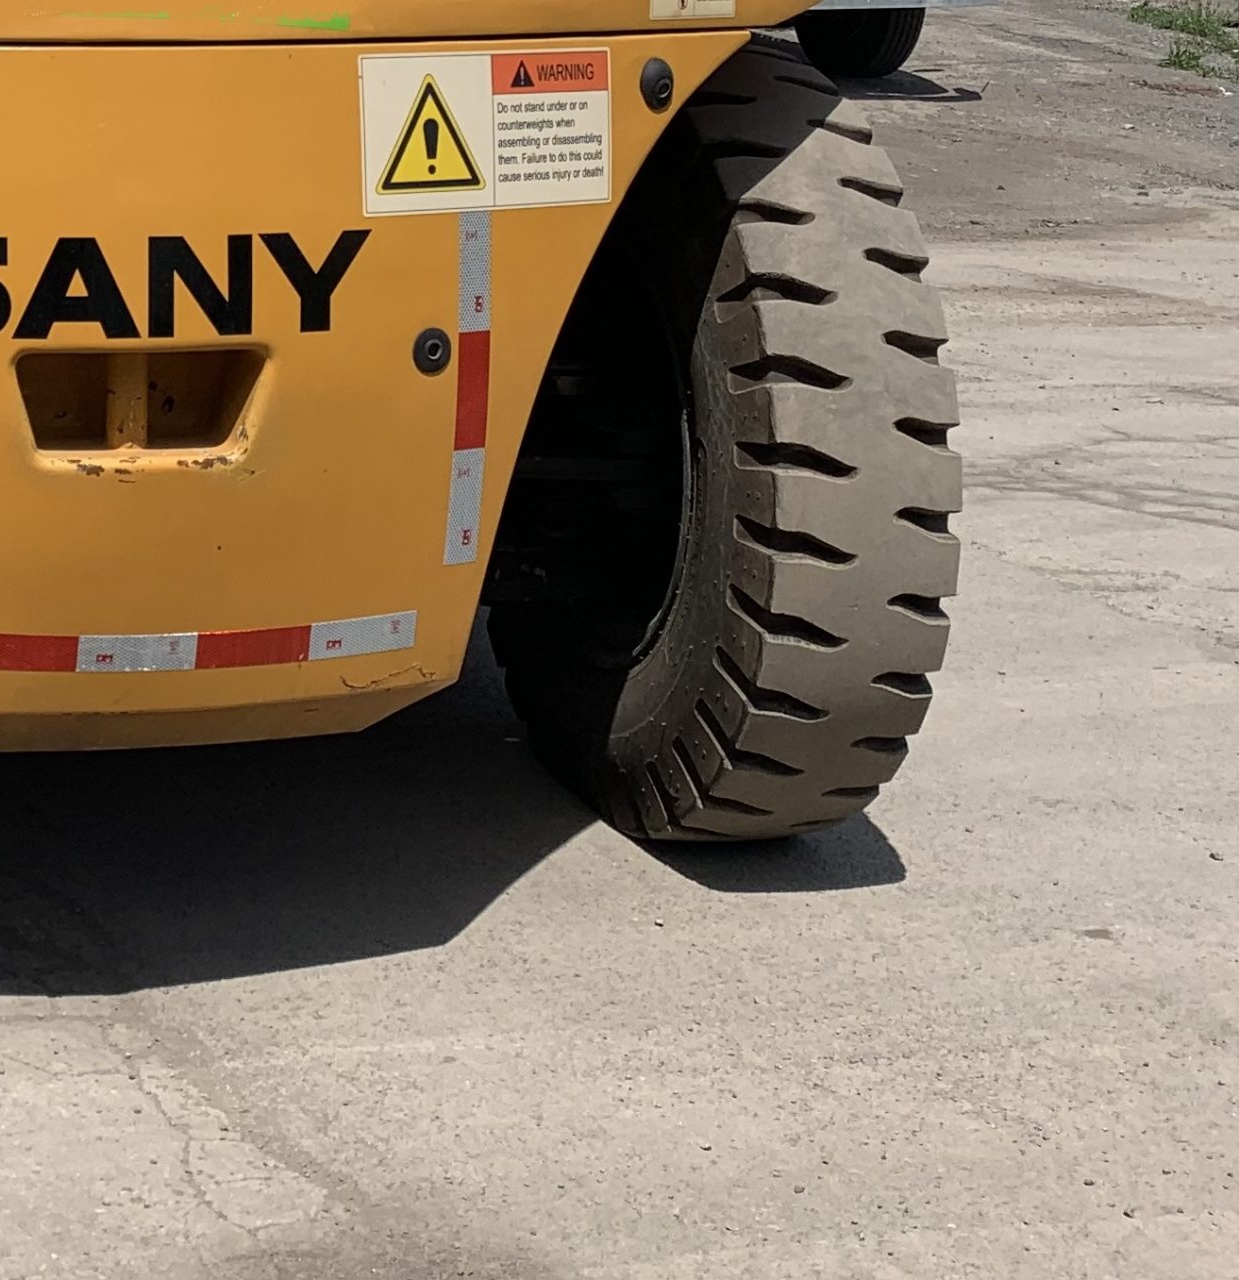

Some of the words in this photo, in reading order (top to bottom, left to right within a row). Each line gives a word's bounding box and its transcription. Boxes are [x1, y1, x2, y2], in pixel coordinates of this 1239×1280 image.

[536, 63, 594, 82] WARNING
[497, 102, 508, 114] Do
[510, 102, 523, 114] not
[524, 100, 545, 113] stand
[546, 100, 567, 112] under
[569, 102, 578, 111] or
[578, 101, 588, 111] on
[497, 117, 554, 132] counterweights
[555, 118, 575, 129] when
[498, 136, 540, 149] assembling
[542, 137, 550, 146] or
[552, 133, 602, 147] disassembling
[498, 153, 519, 165] them.
[522, 152, 547, 164] Failure
[548, 152, 556, 163] to
[558, 151, 568, 162] do
[569, 150, 581, 162] this
[583, 149, 602, 161] could
[498, 172, 521, 182] cause
[523, 170, 550, 181] serious
[552, 168, 571, 183] injury
[573, 169, 581, 178] or
[582, 166, 604, 179] death!
